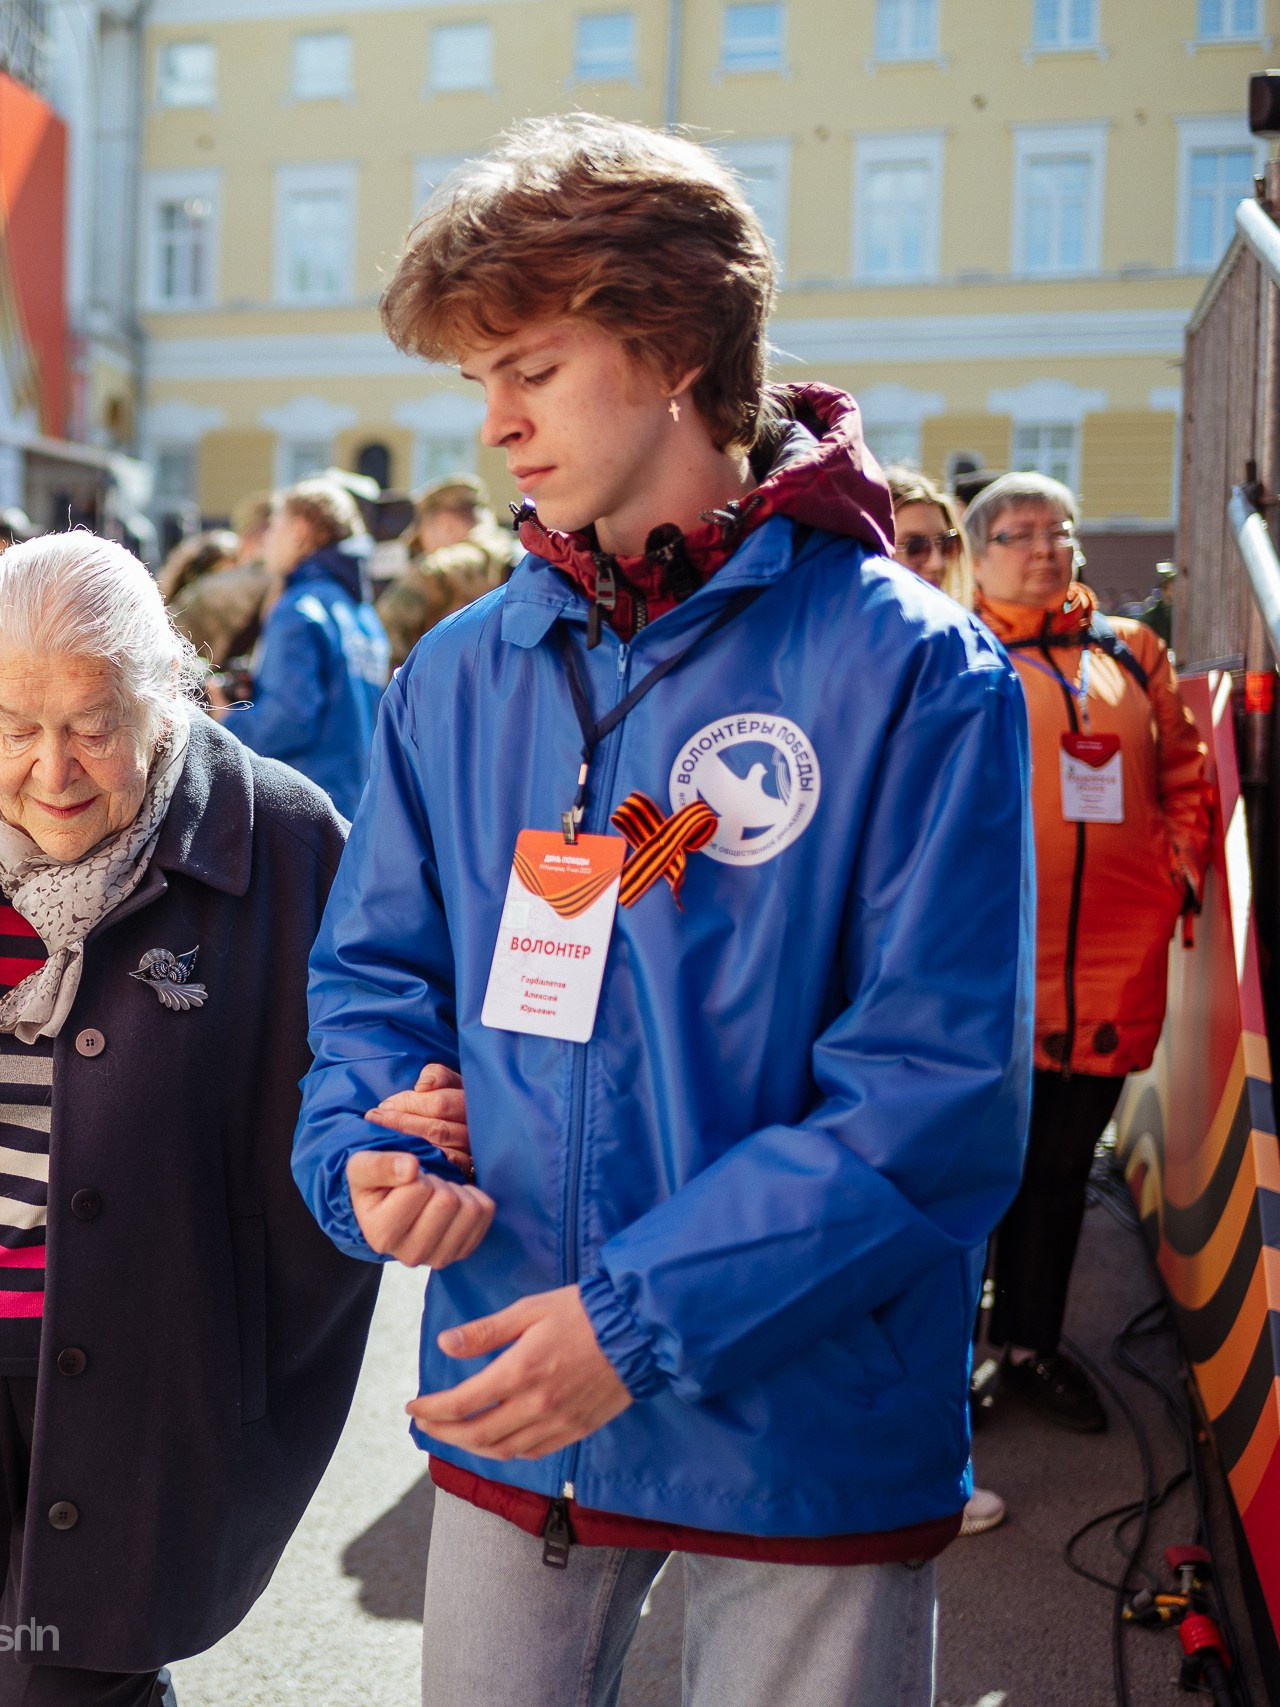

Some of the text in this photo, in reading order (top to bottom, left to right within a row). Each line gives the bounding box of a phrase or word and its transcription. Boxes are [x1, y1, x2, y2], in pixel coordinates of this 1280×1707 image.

[677, 718, 814, 792] ВОЛОНТЁРЫ ПОБЕДЫ
[510, 936, 592, 960] ВОЛОНТЕР
